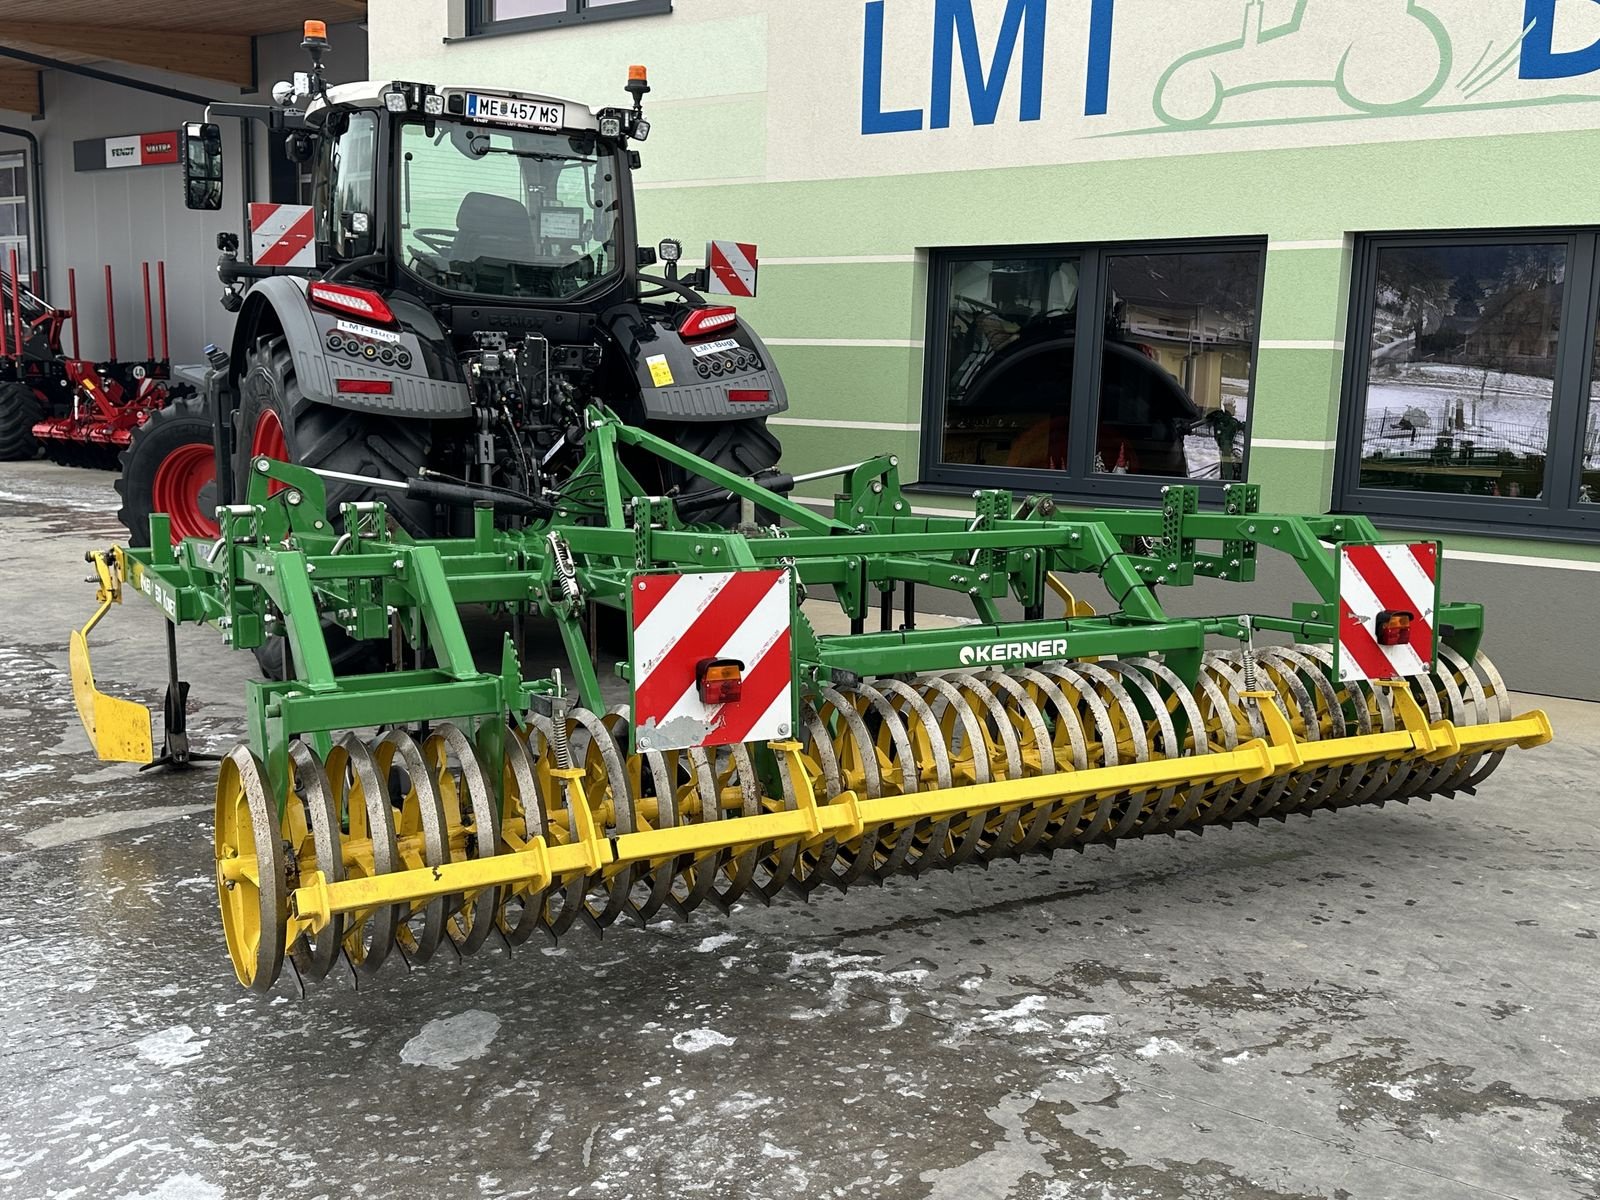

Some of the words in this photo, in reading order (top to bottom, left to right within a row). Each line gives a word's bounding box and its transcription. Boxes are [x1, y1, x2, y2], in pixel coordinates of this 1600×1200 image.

[479, 98, 499, 116] ME
[510, 103, 537, 121] 457
[539, 106, 559, 124] MS
[111, 147, 135, 157] FENDT
[694, 339, 735, 353] LMT-Bugl
[134, 368, 144, 377] 40
[976, 639, 1068, 663] KERNER
